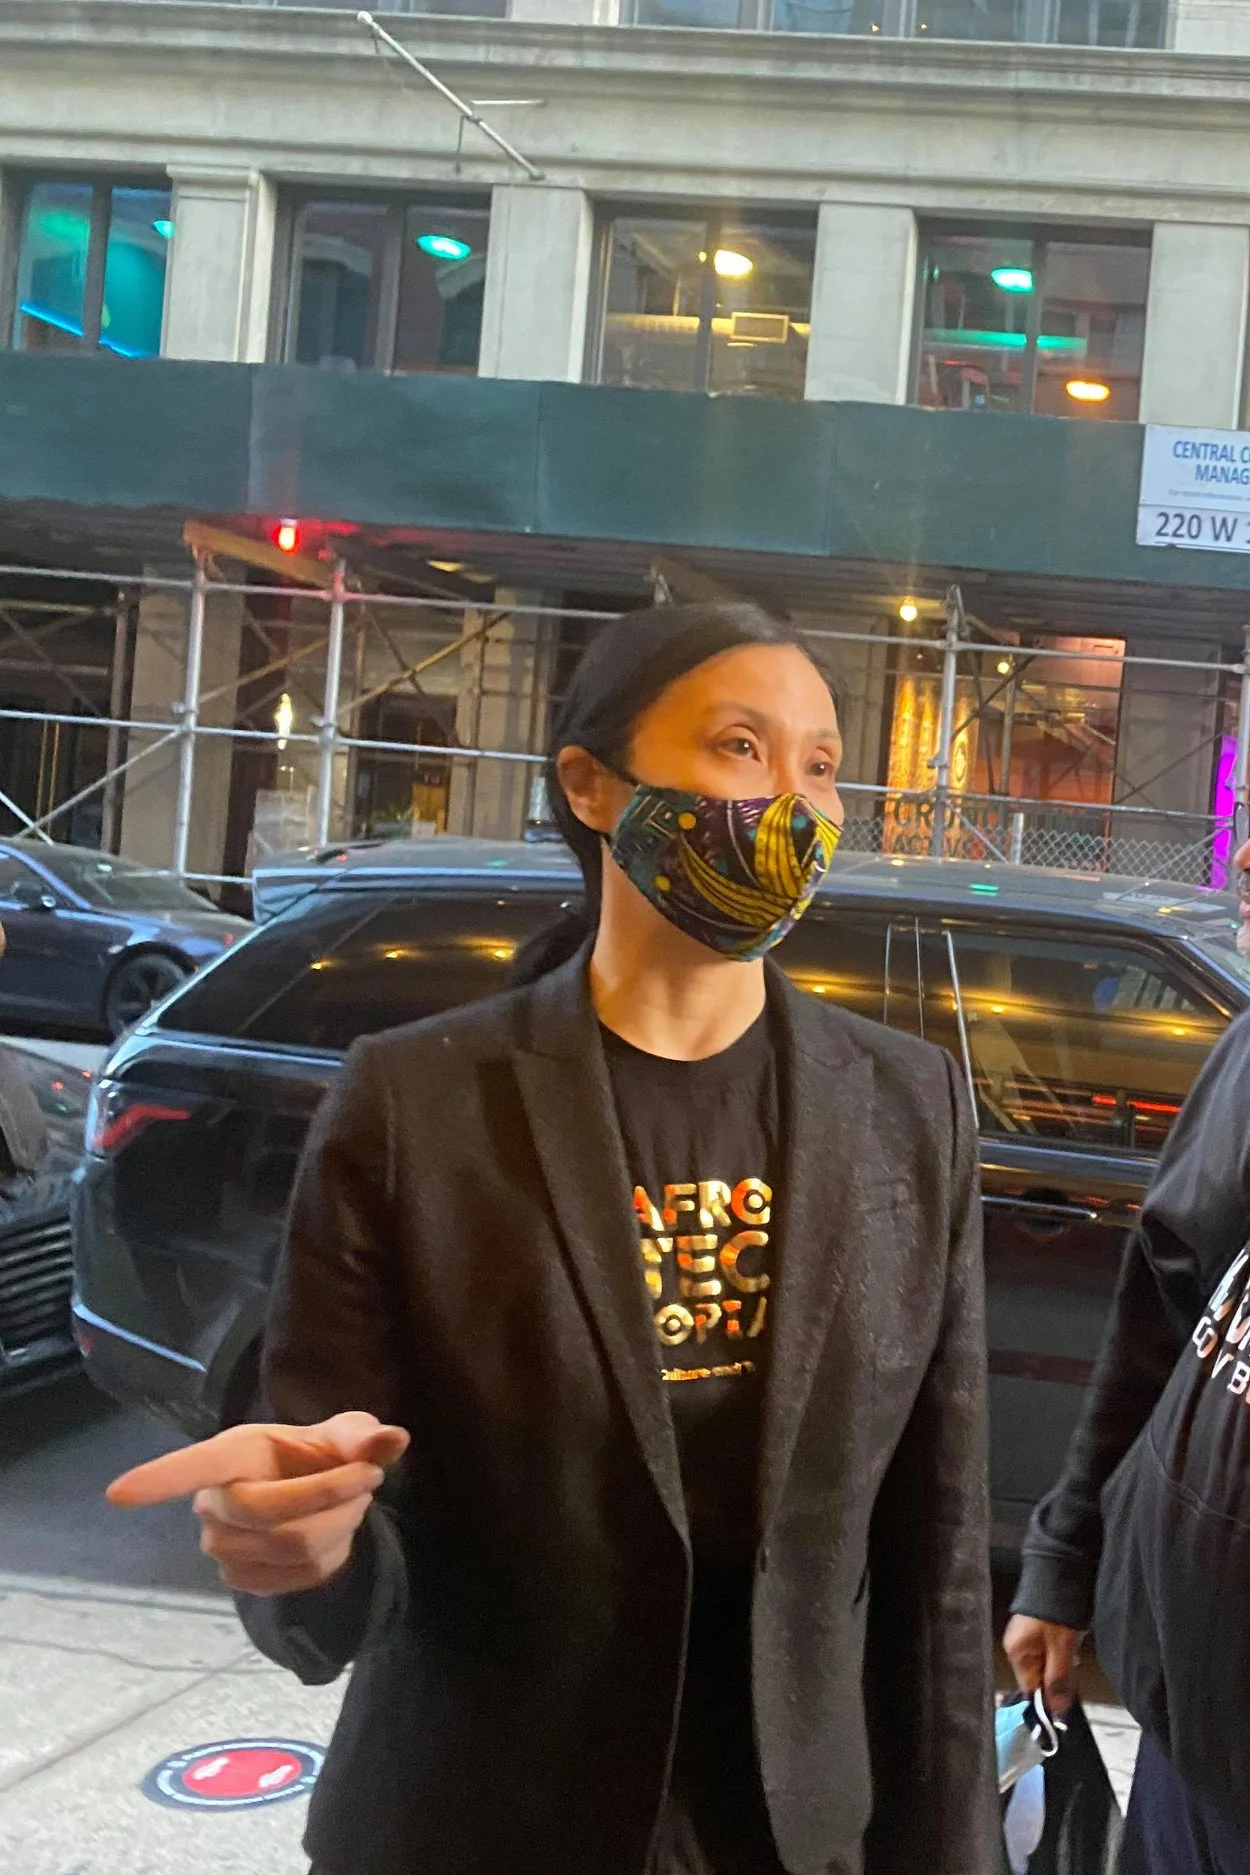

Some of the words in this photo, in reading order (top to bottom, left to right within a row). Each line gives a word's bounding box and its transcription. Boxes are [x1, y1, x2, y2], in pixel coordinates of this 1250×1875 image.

[1172, 440, 1236, 463] CENTRAL
[1155, 511, 1203, 540] 220
[1211, 515, 1239, 542] W
[632, 1177, 773, 1232] AFRO
